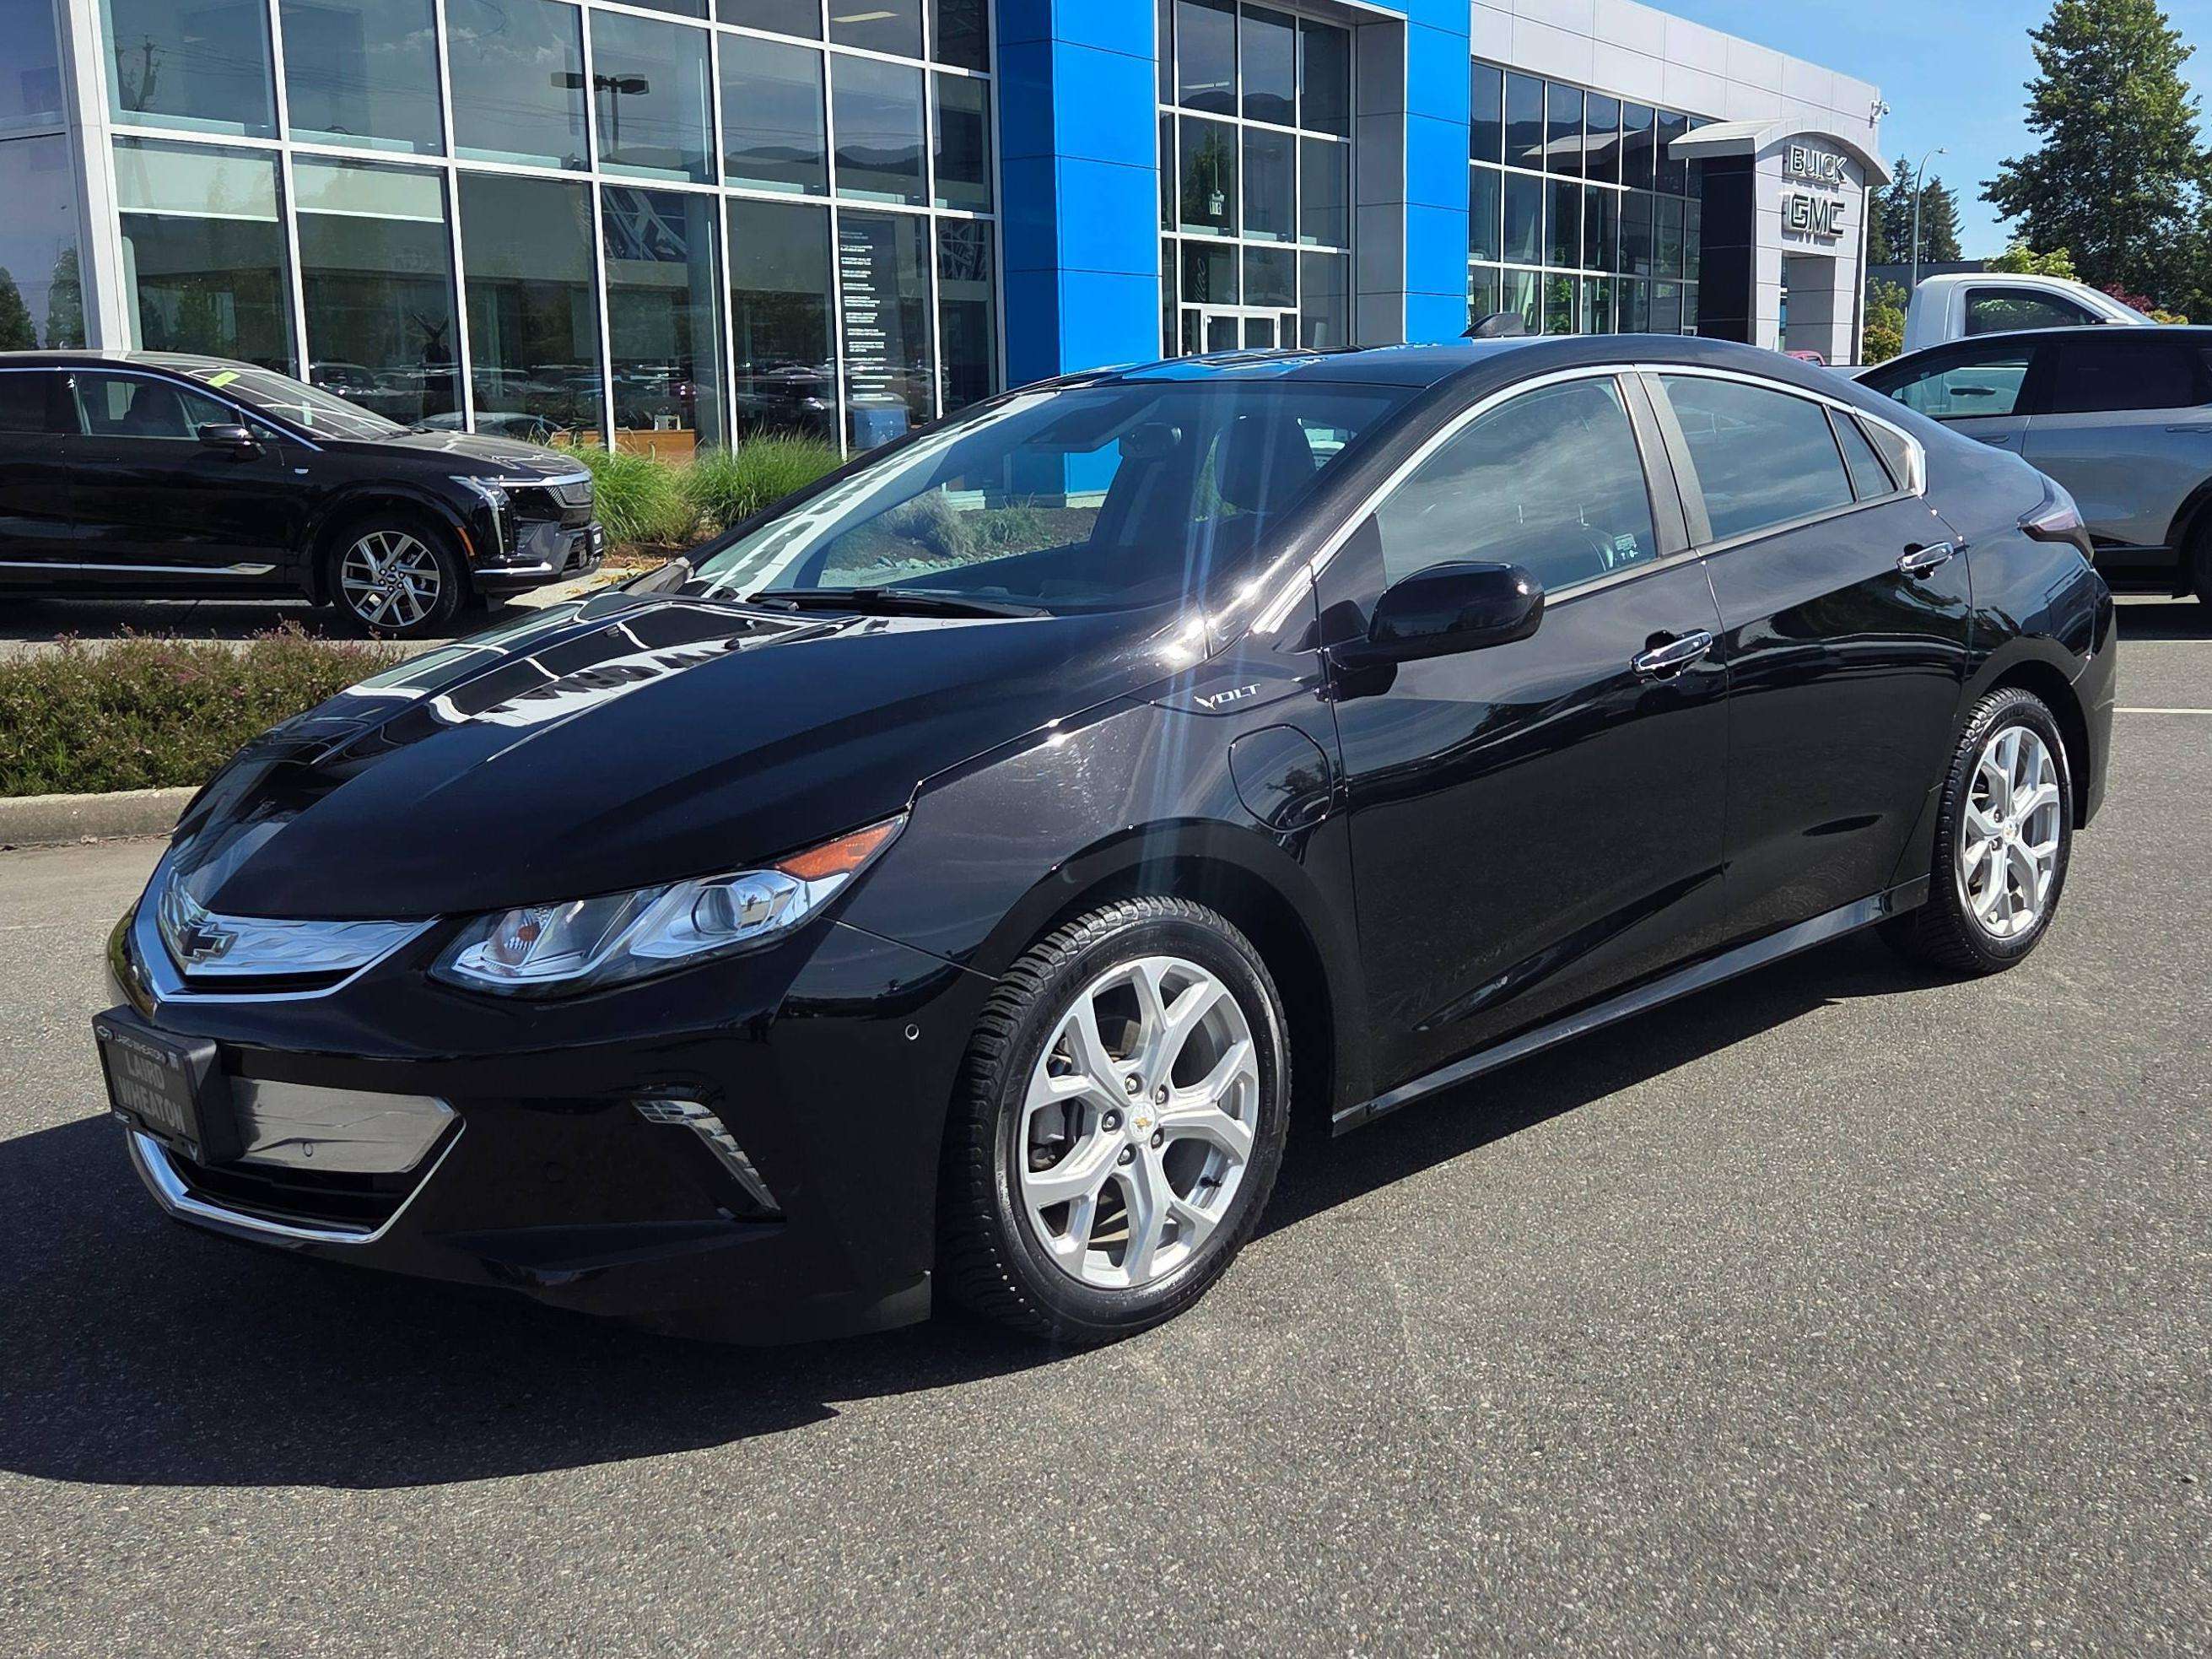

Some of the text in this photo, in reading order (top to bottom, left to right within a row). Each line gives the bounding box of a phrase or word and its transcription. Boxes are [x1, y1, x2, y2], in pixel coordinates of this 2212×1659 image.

[1790, 144, 1847, 184] BUICK
[1791, 193, 1845, 237] GMC
[1194, 683, 1260, 710] VOLT
[118, 1075, 186, 1134] WHEATON
